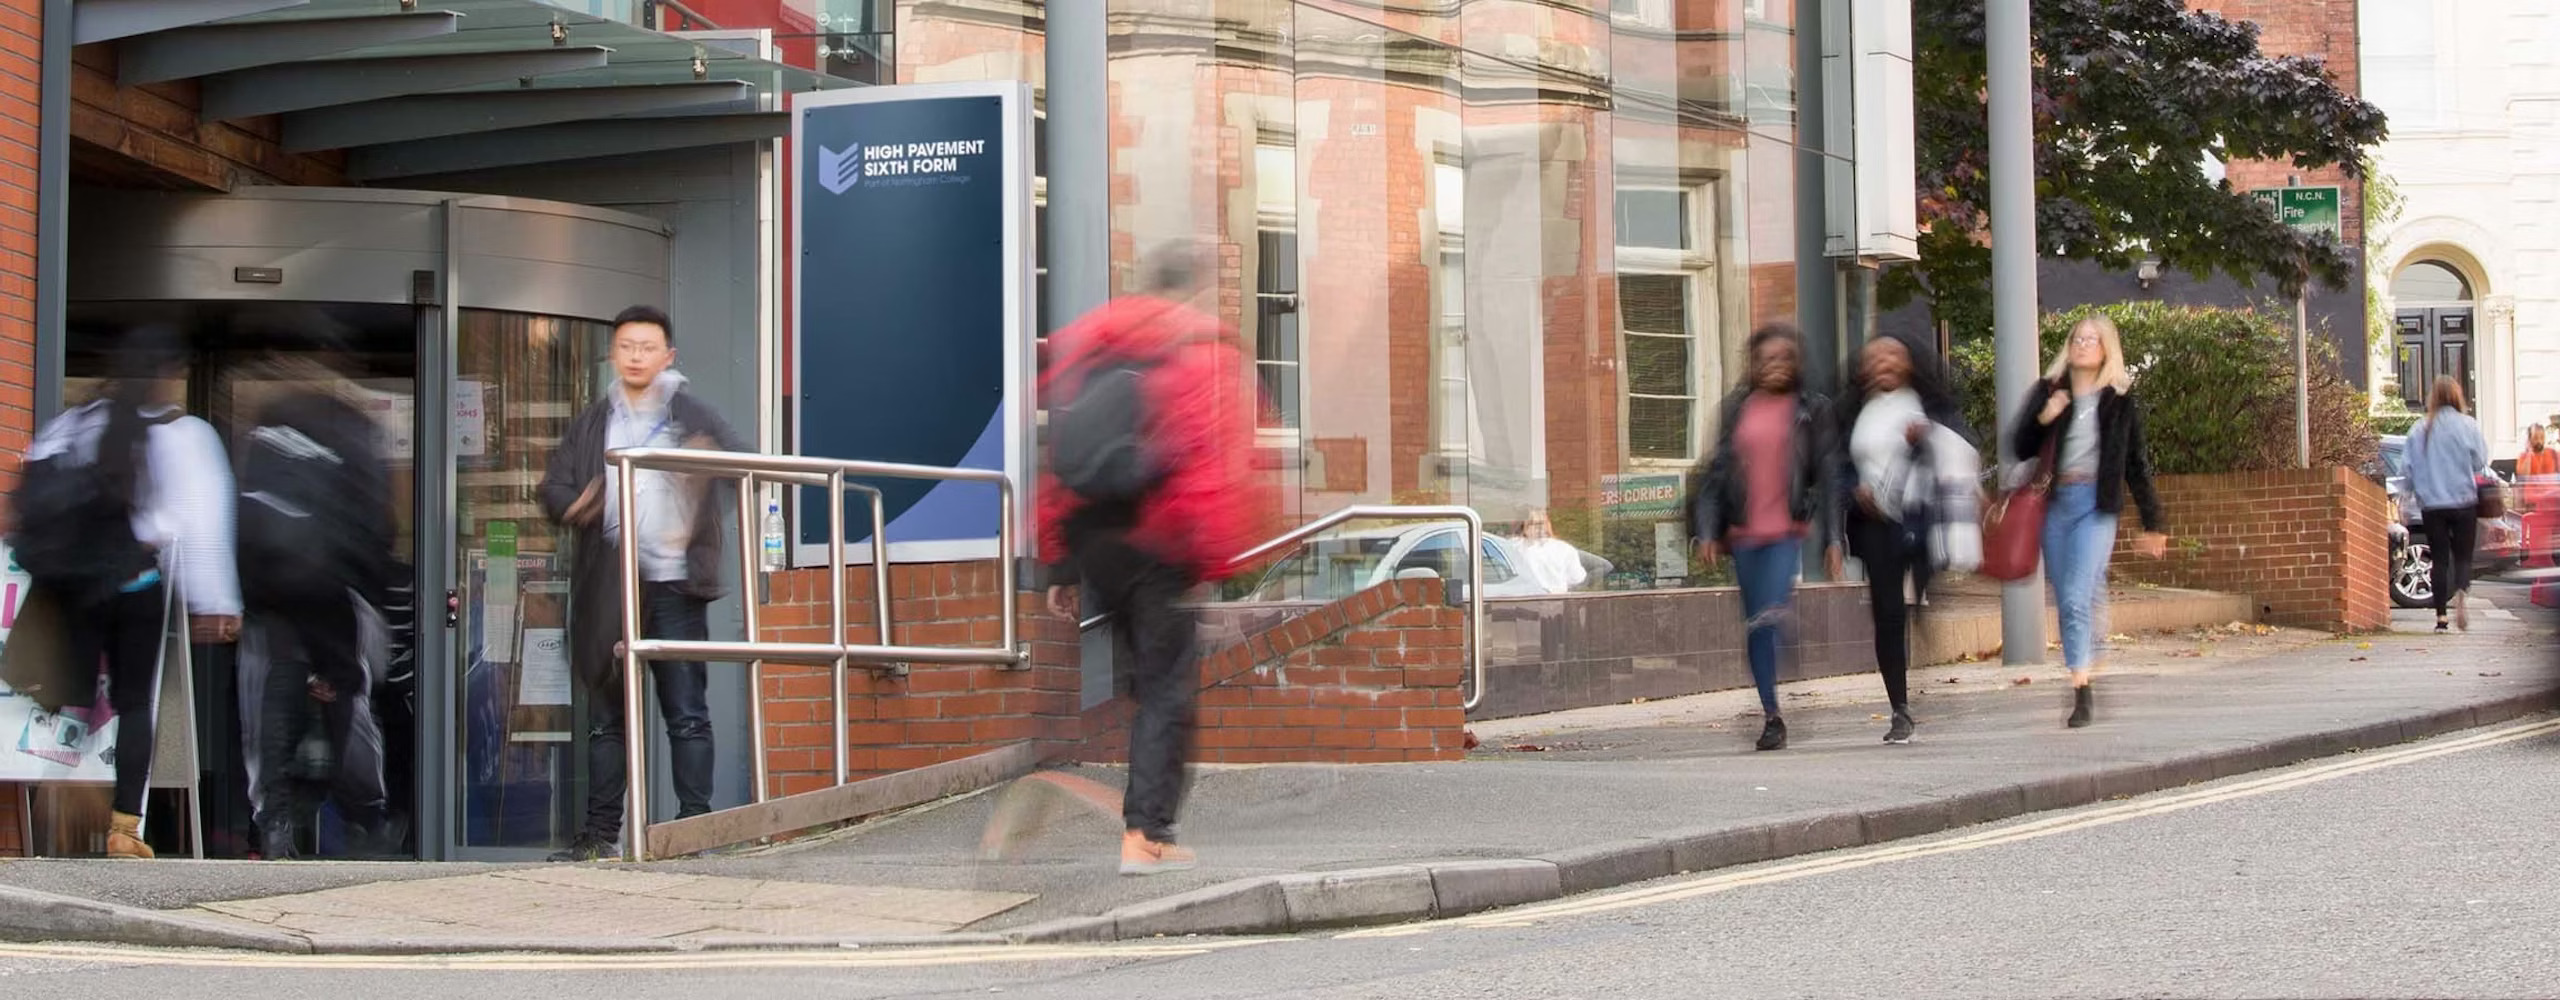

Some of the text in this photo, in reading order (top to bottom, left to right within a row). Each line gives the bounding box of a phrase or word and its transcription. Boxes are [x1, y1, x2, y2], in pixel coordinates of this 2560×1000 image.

[864, 139, 985, 160] HIGH PAVEMENT
[864, 157, 957, 176] SIXTH FORM
[2295, 191, 2325, 201] N.C.N.
[2283, 206, 2305, 218] Fire
[1624, 484, 1673, 503] CORNER
